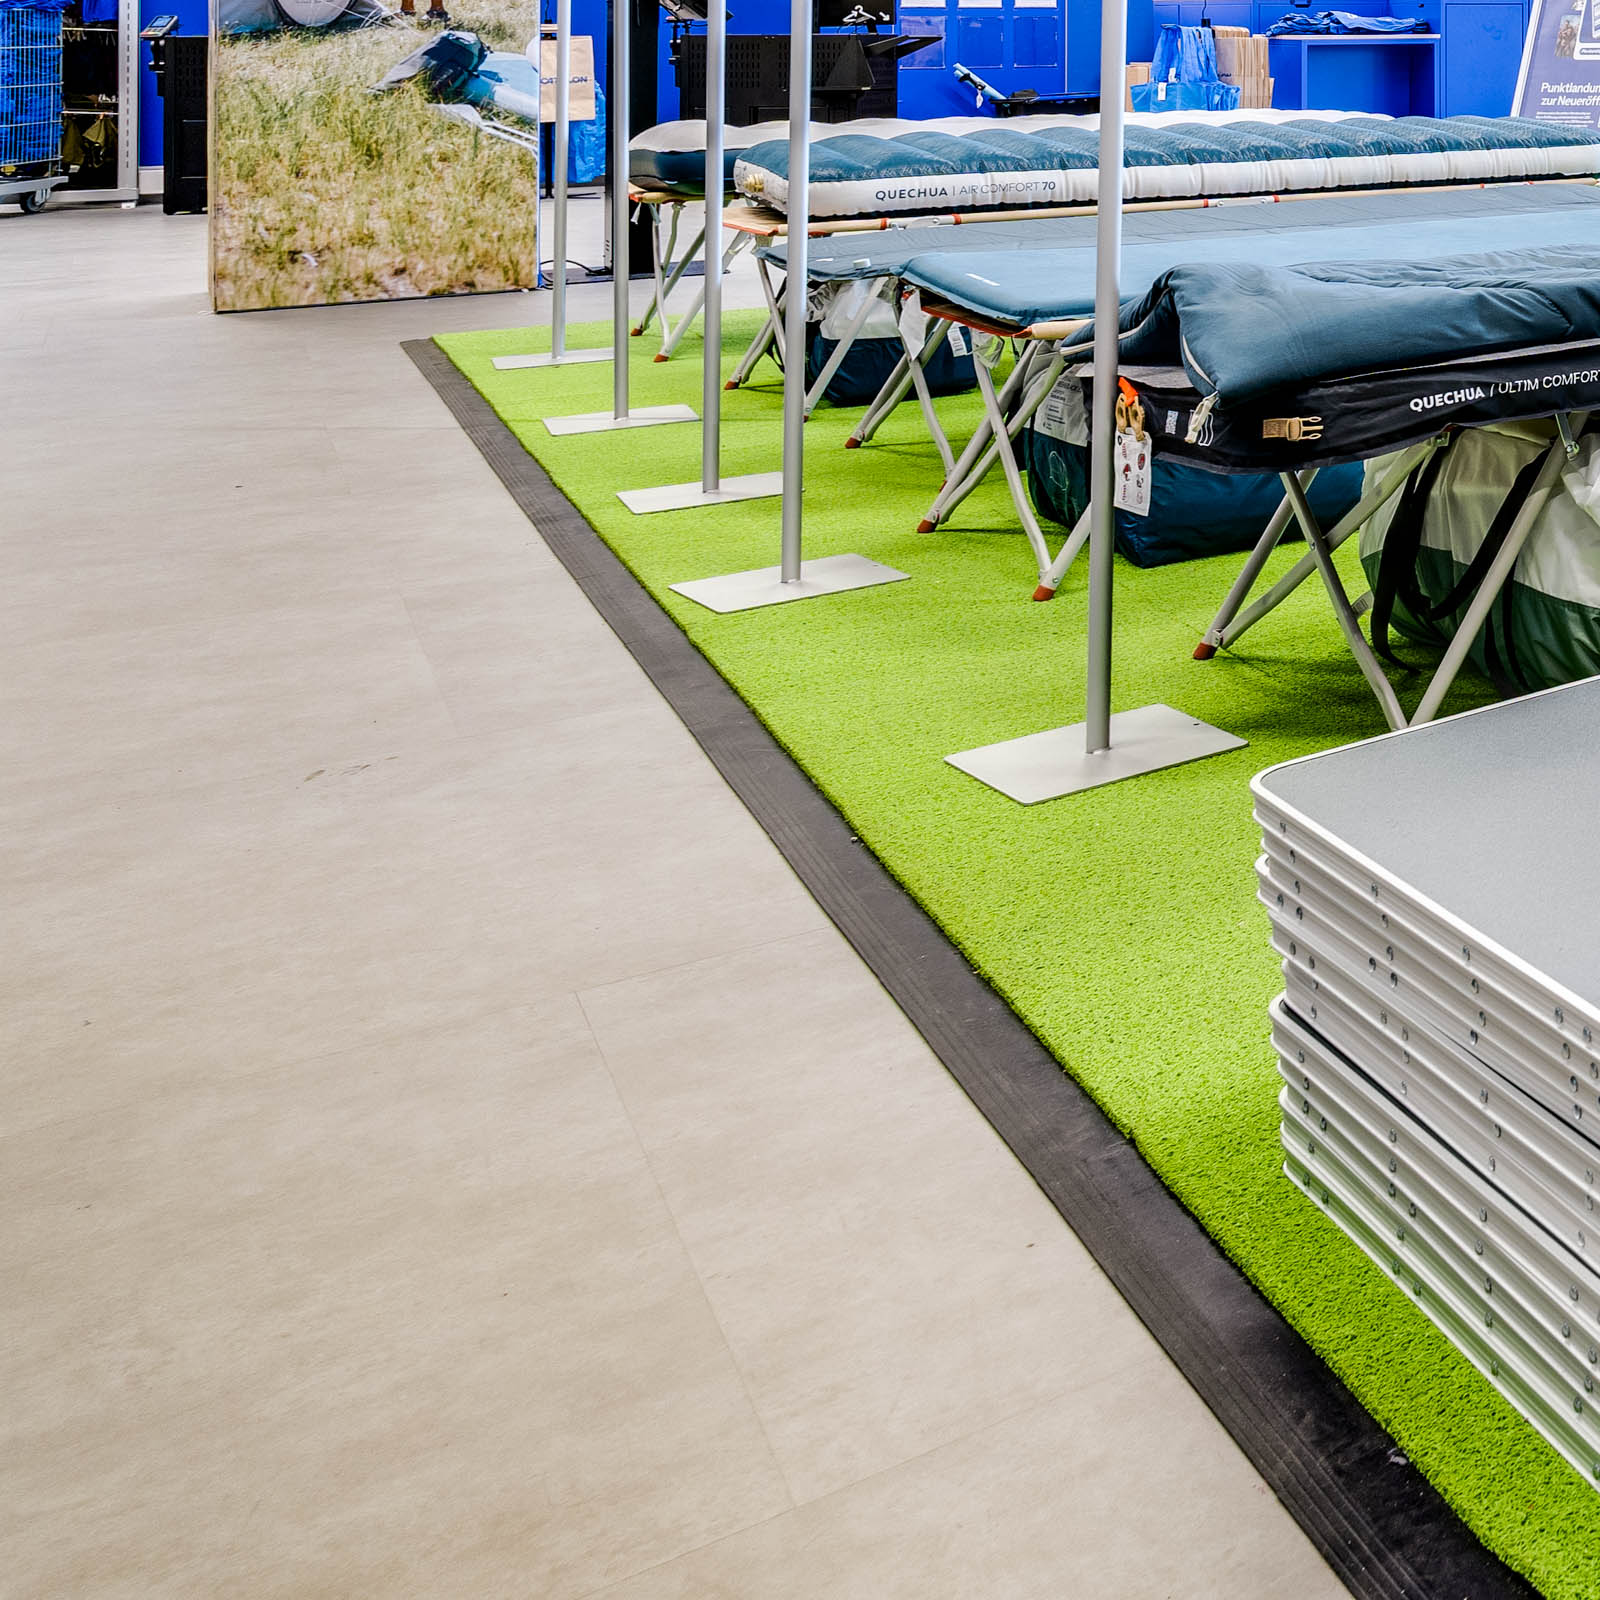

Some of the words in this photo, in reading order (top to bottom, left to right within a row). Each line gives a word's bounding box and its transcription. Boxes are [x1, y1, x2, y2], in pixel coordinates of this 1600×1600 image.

[1541, 97, 1558, 106] zur
[875, 187, 948, 201] QUECHUA
[959, 185, 978, 196] AIR
[981, 181, 1040, 194] COMFORT
[1042, 181, 1056, 191] 70
[1409, 386, 1485, 412] QUECHUA
[1498, 378, 1540, 394] ULTIM
